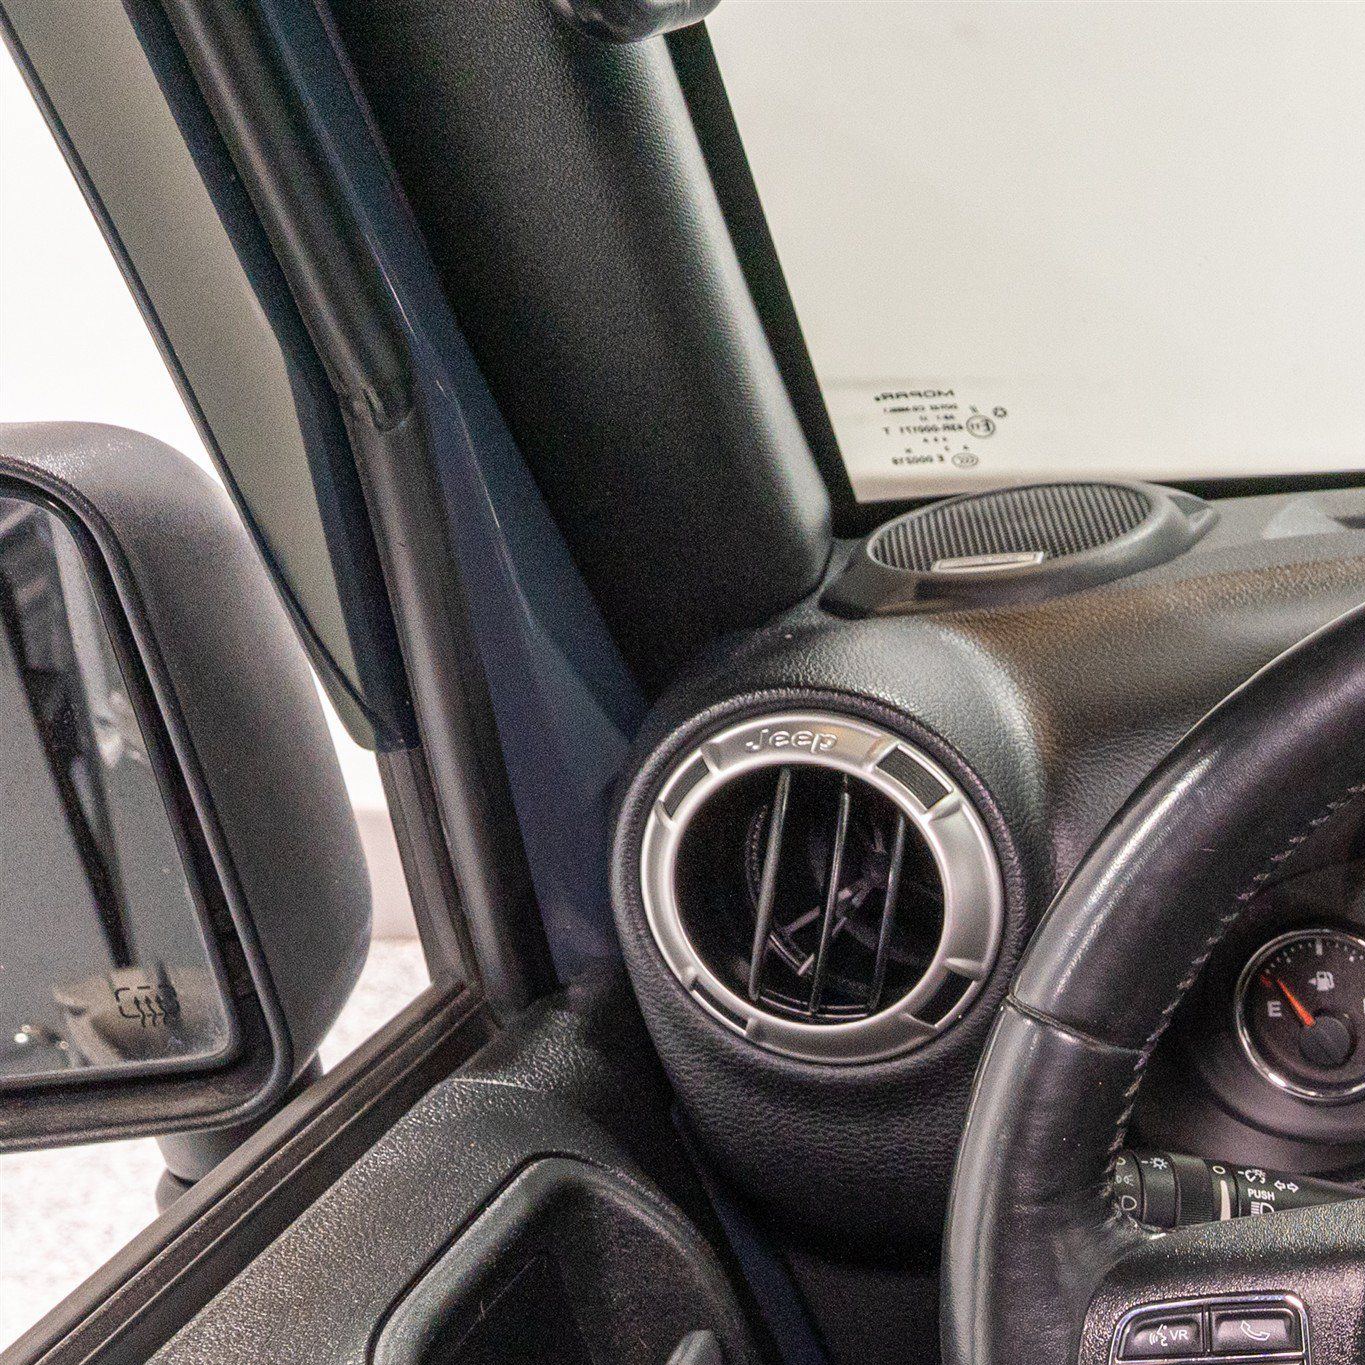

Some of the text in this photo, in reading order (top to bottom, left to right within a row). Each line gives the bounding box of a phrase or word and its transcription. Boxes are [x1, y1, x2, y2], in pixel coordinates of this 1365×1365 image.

[745, 728, 838, 754] Jeep
[1267, 1001, 1282, 1018] E
[1247, 1188, 1275, 1201] PUSH
[1169, 1329, 1188, 1341] VR
